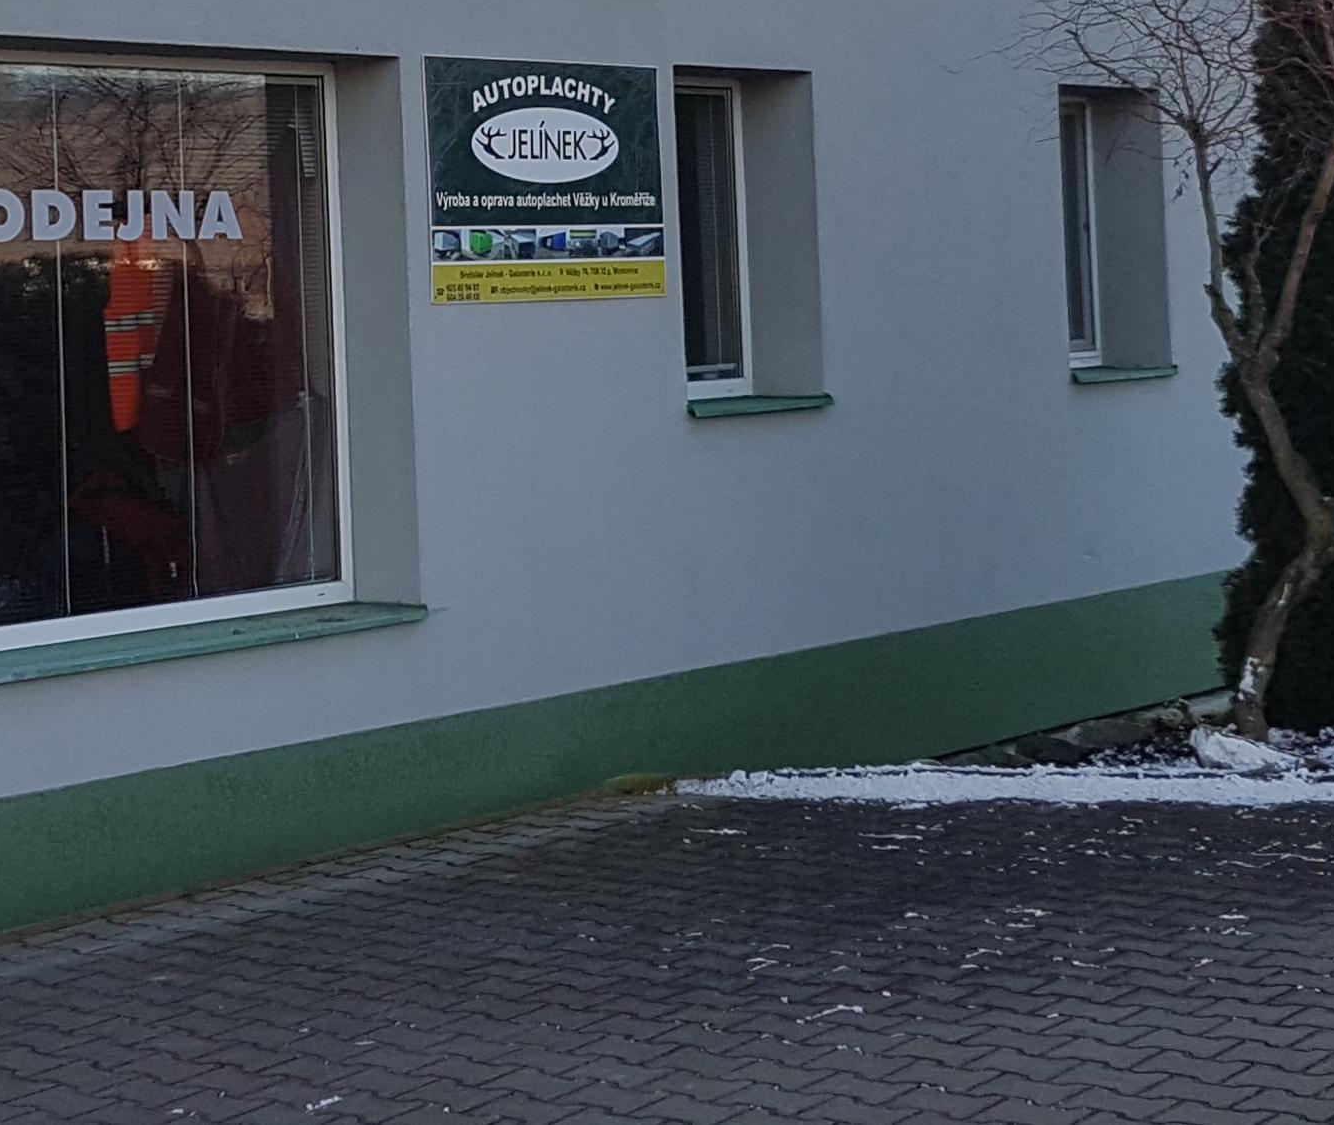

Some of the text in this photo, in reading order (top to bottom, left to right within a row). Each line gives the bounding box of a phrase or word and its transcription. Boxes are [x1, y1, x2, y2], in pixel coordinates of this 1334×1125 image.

[472, 74, 616, 115] AUTOPLACHTY
[507, 120, 588, 161] JELÍNEK
[436, 190, 656, 211] Výroba a oprava autoplachet Věžky u Kroměříže
